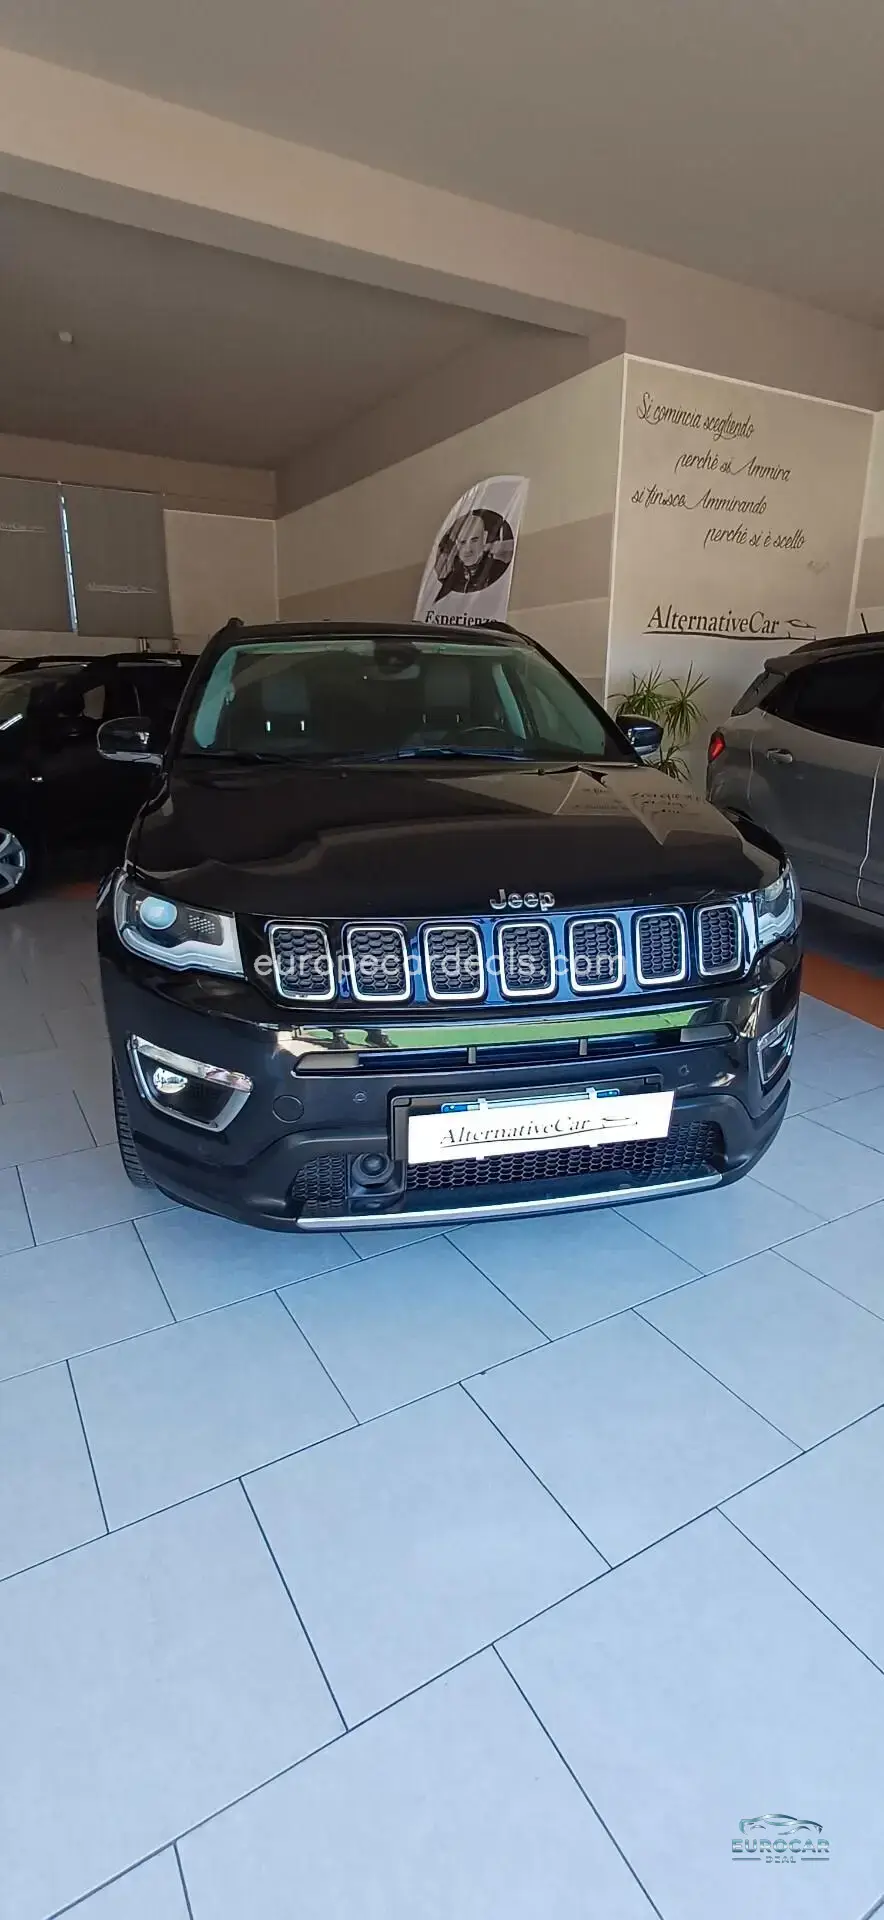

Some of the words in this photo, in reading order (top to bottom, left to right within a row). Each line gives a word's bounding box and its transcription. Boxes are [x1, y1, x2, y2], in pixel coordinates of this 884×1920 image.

[653, 405, 701, 427] comincia
[703, 411, 754, 441] scegliendo
[737, 455, 792, 481] Ammira
[631, 486, 645, 503] si
[645, 484, 687, 508] finisce
[698, 489, 767, 514] Ammirando
[749, 529, 763, 547] si
[647, 604, 780, 634] AlternativeCar
[490, 888, 556, 911] Jeep
[440, 1114, 591, 1145] AlternativeCar
